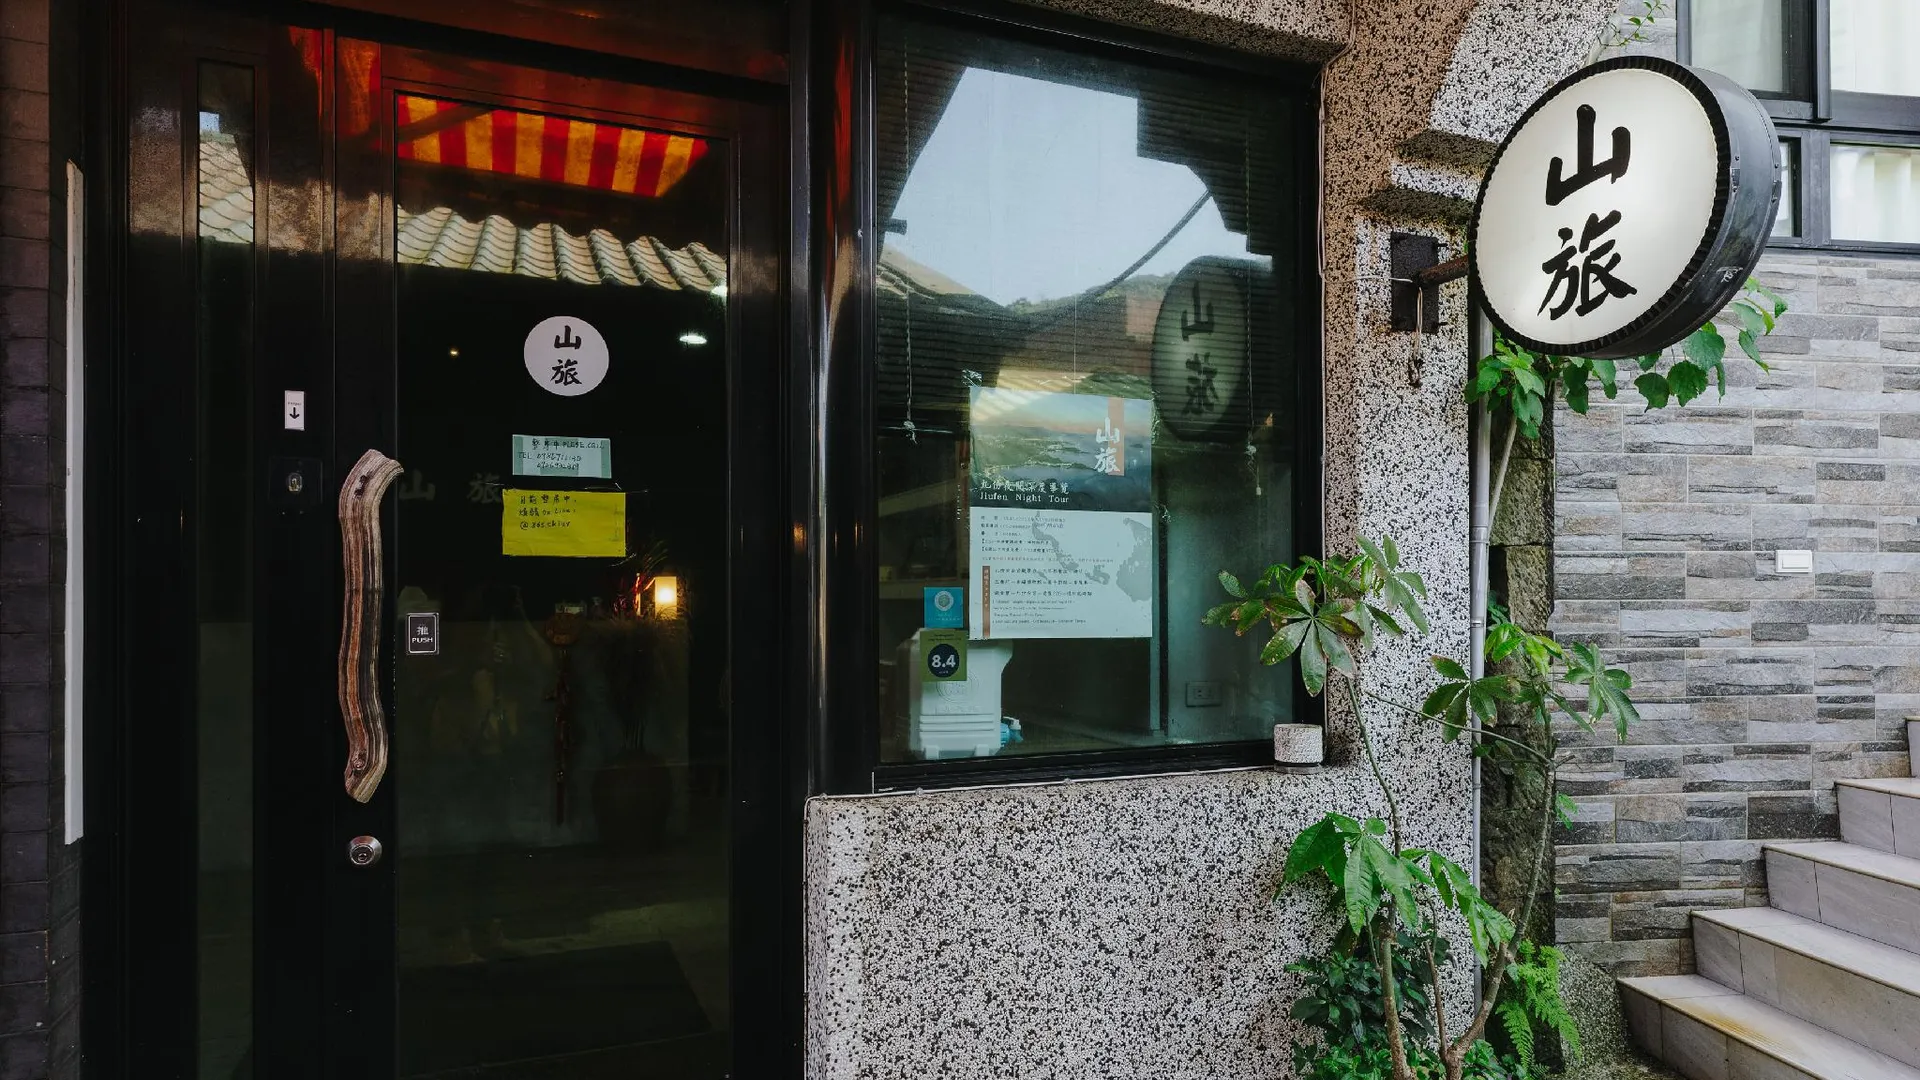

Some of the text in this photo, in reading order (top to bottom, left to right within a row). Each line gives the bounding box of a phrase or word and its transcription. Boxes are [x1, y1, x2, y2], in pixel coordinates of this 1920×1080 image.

[1538, 104, 1638, 321] 山旅
[550, 325, 582, 386] 山旅
[518, 451, 532, 459] TEL
[1094, 417, 1120, 473] 山旅
[980, 492, 1069, 503] Jiufen Night Tour
[931, 654, 956, 668] 8.4
